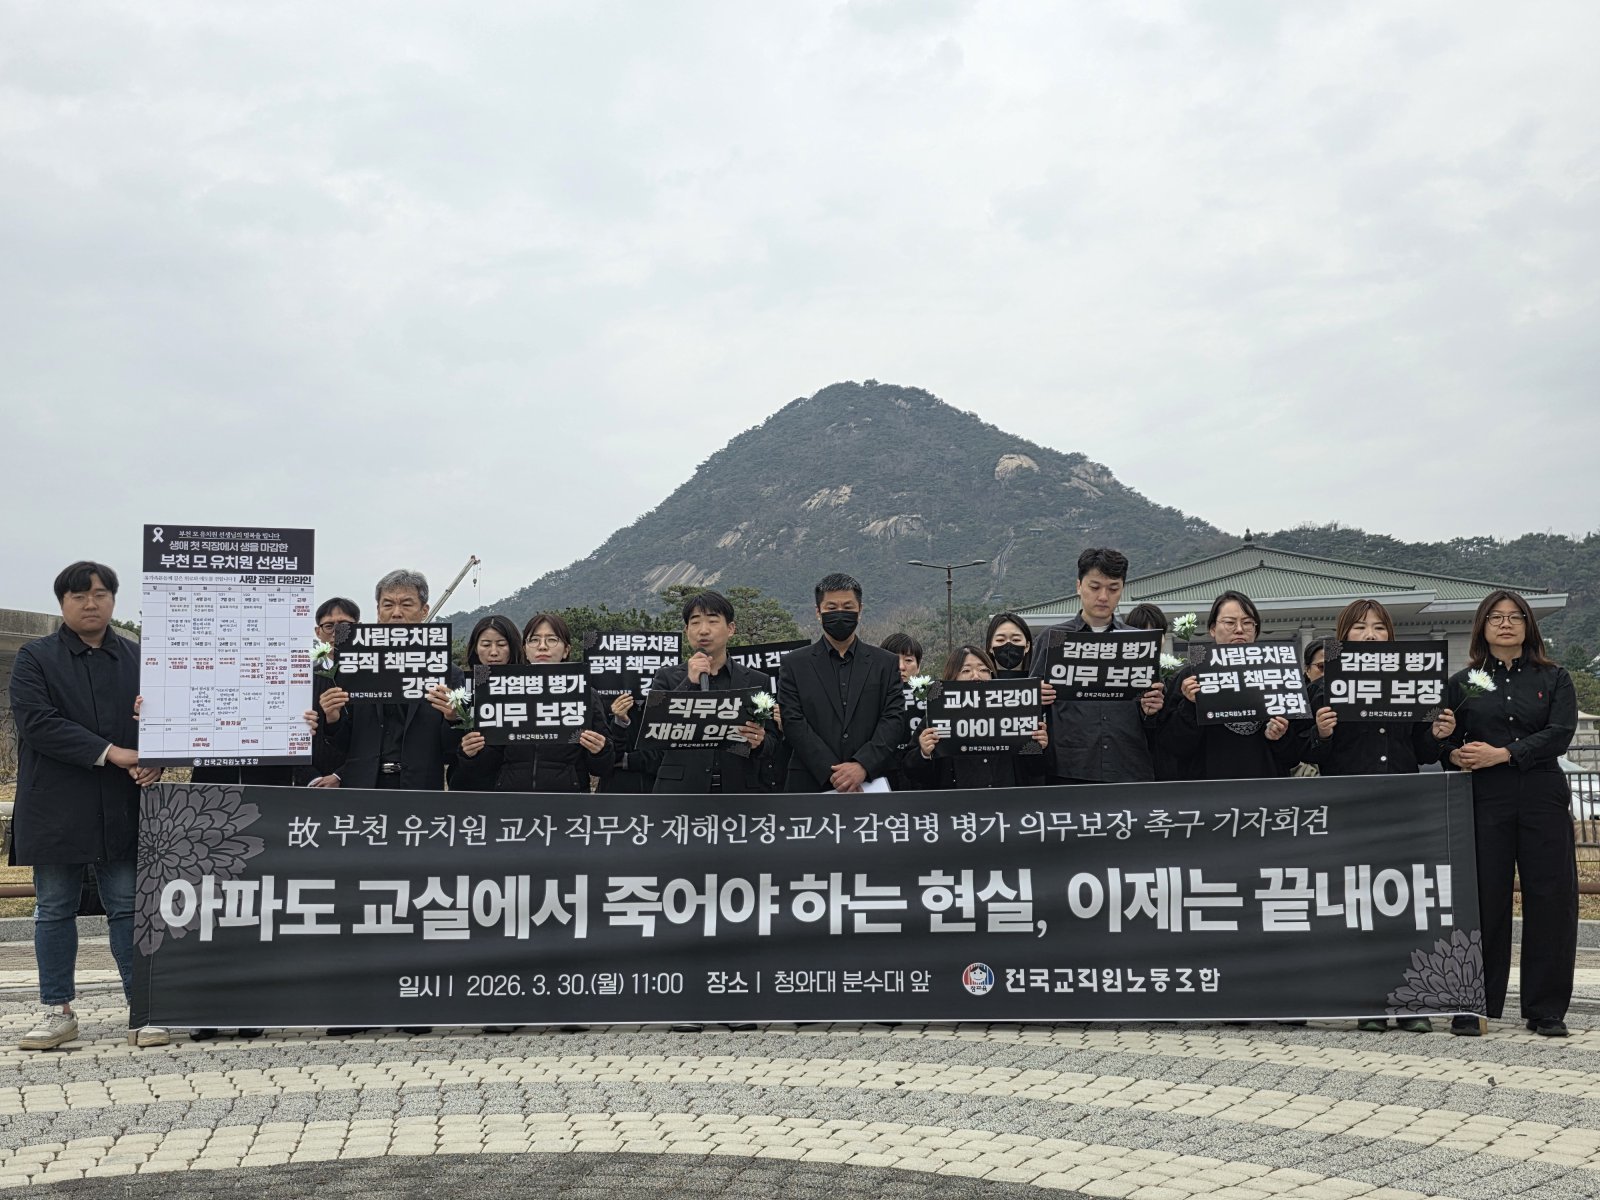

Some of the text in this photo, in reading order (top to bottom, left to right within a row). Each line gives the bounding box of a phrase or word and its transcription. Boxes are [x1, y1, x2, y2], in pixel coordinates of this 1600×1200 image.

[190, 541, 200, 551] 첫
[201, 541, 239, 551] 직장에서
[239, 542, 259, 552] 생을
[260, 543, 289, 552] 마감한
[160, 554, 298, 570] 부천 모 유치원 선생님
[239, 575, 312, 585] 사망 관련 타임라인
[352, 627, 448, 646] 사립유치원
[599, 635, 679, 652] 사립유치원
[1063, 641, 1158, 659] 감염병 병가
[1210, 646, 1297, 666] 사립유치원
[339, 651, 448, 673] 공적 책무성
[589, 656, 679, 674] 공적 책무성
[1340, 652, 1444, 671] 감염병 병가
[489, 674, 587, 695] 감염병 병가
[1049, 664, 1155, 688] 의무 보장
[1199, 669, 1302, 693] 공적 책무성
[402, 677, 447, 698] 강화
[1329, 680, 1444, 704] 의무 보장
[668, 697, 742, 719] 직무상
[944, 690, 980, 709] 교사
[985, 688, 1038, 708] 건강이
[1264, 693, 1306, 715] 강화
[479, 701, 586, 727] 의무 보장
[644, 723, 749, 742] 재해 인정
[956, 718, 995, 737] 아이
[1000, 716, 1038, 736] 안전
[204, 758, 259, 766] 전국교직원노동조합
[288, 816, 321, 848] 故
[327, 814, 388, 847] 부천
[397, 814, 488, 846] 유치원
[495, 814, 558, 846] 교사
[564, 815, 654, 846] 직무상
[853, 812, 940, 844] 감염병
[951, 811, 1011, 843] 병가
[1018, 810, 1137, 842] 의무보장
[1143, 809, 1205, 839] 촉구
[1212, 806, 1329, 838] 기자회견
[159, 863, 1455, 942] 아파도 교실에서 죽어야 하는 현실, 이제는 끝내야!
[399, 973, 684, 998] 일시 2026. 3. 30.(월) 11:00
[706, 971, 932, 995] 장소 청와대 분수대 앞
[1005, 967, 1221, 994] 전국교직원노동조합
